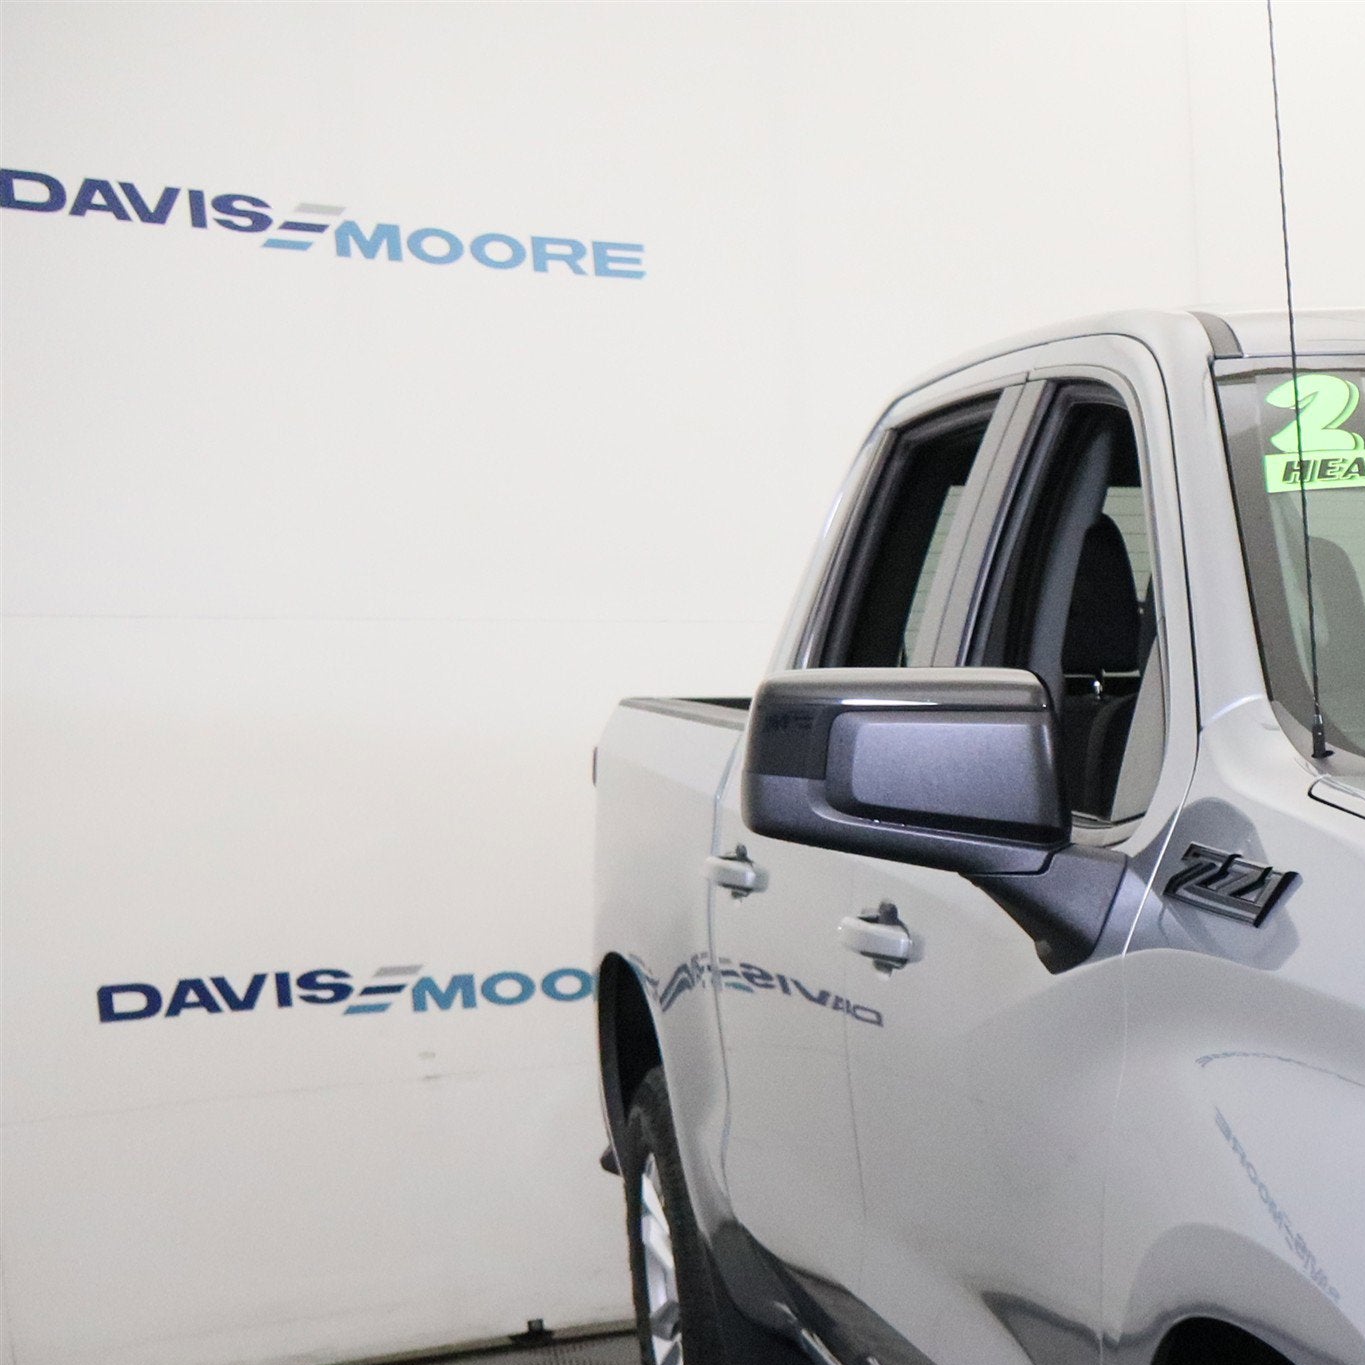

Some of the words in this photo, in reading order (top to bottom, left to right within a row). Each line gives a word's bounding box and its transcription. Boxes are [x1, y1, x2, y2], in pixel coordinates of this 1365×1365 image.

[0, 168, 273, 234] DAVIS
[334, 219, 647, 280] MOORE
[96, 967, 351, 1024] DAVIS
[410, 967, 598, 1014] MOO
